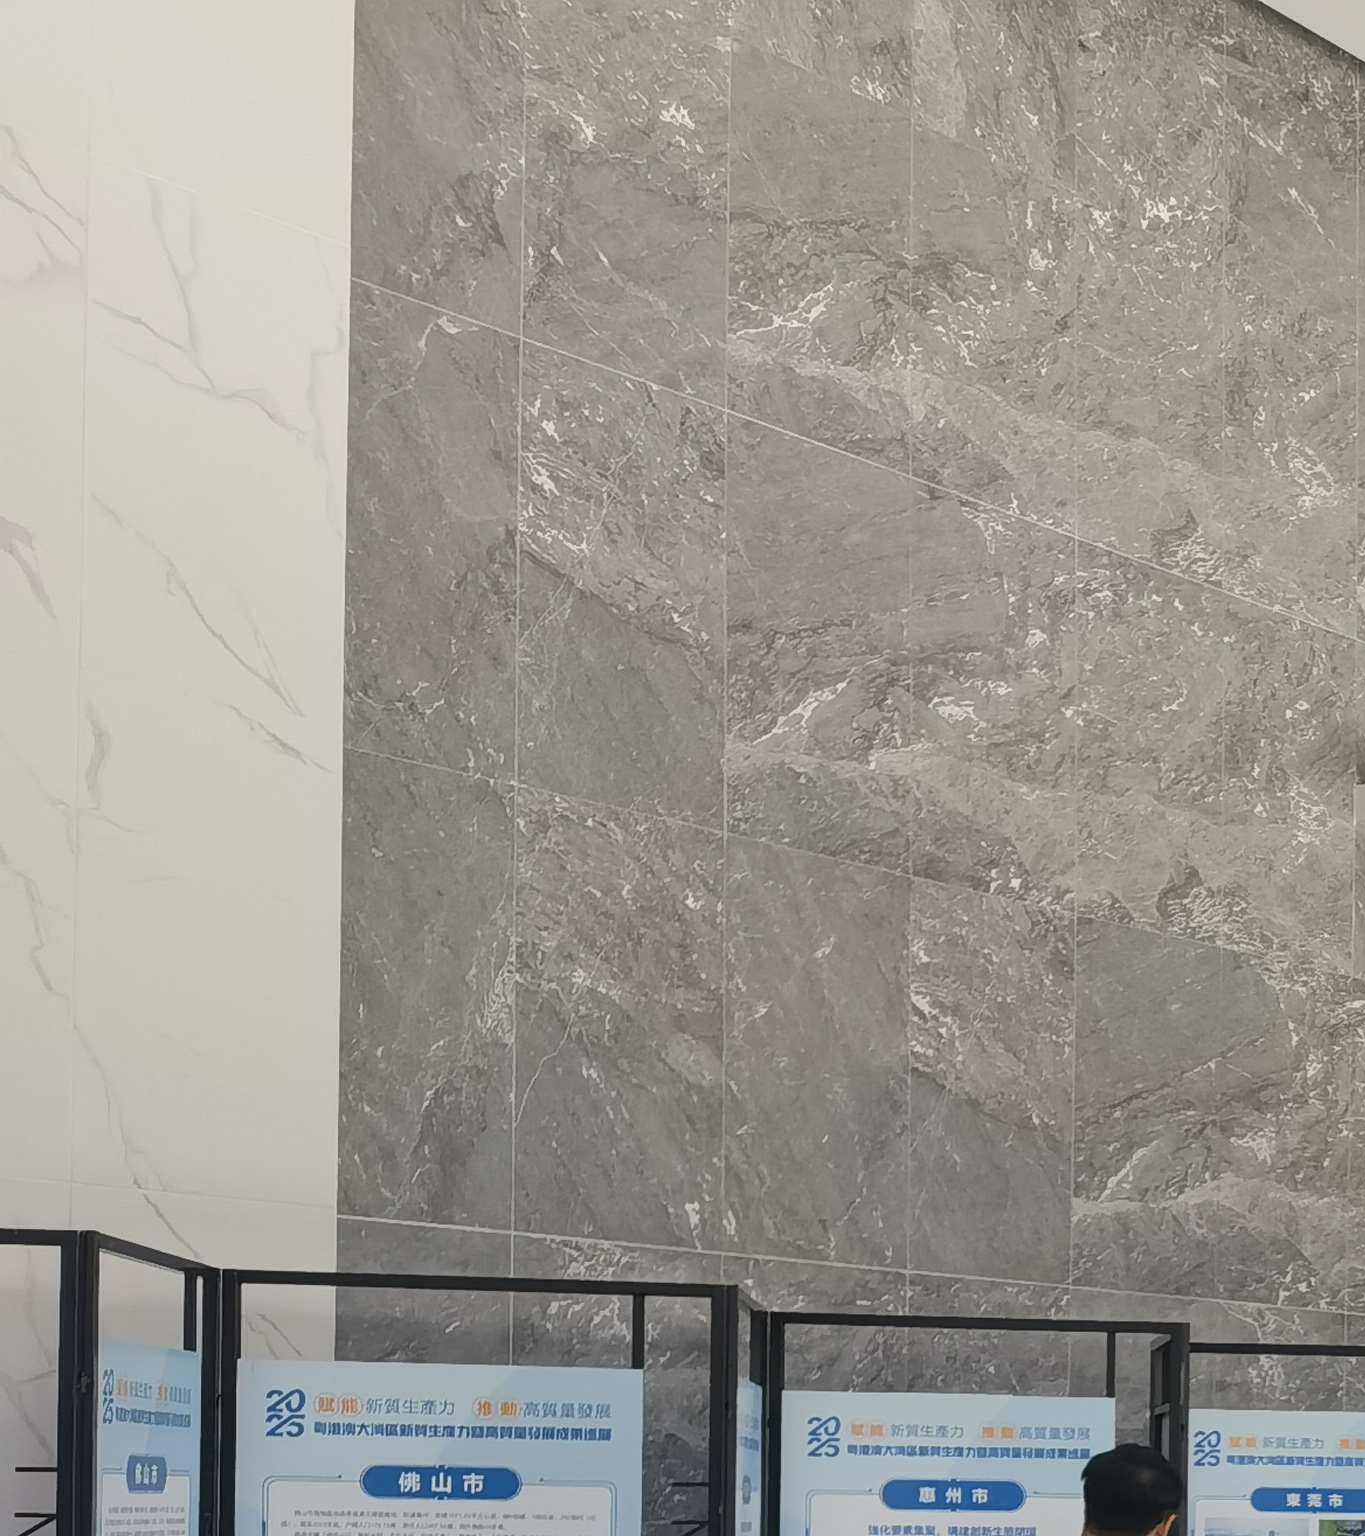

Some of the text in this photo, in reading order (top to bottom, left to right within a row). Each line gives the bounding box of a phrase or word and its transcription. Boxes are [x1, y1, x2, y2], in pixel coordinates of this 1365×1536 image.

[398, 1471, 485, 1494] 佛山市
[919, 1487, 988, 1504] 惠州市
[1286, 1494, 1344, 1508] 東莞市
